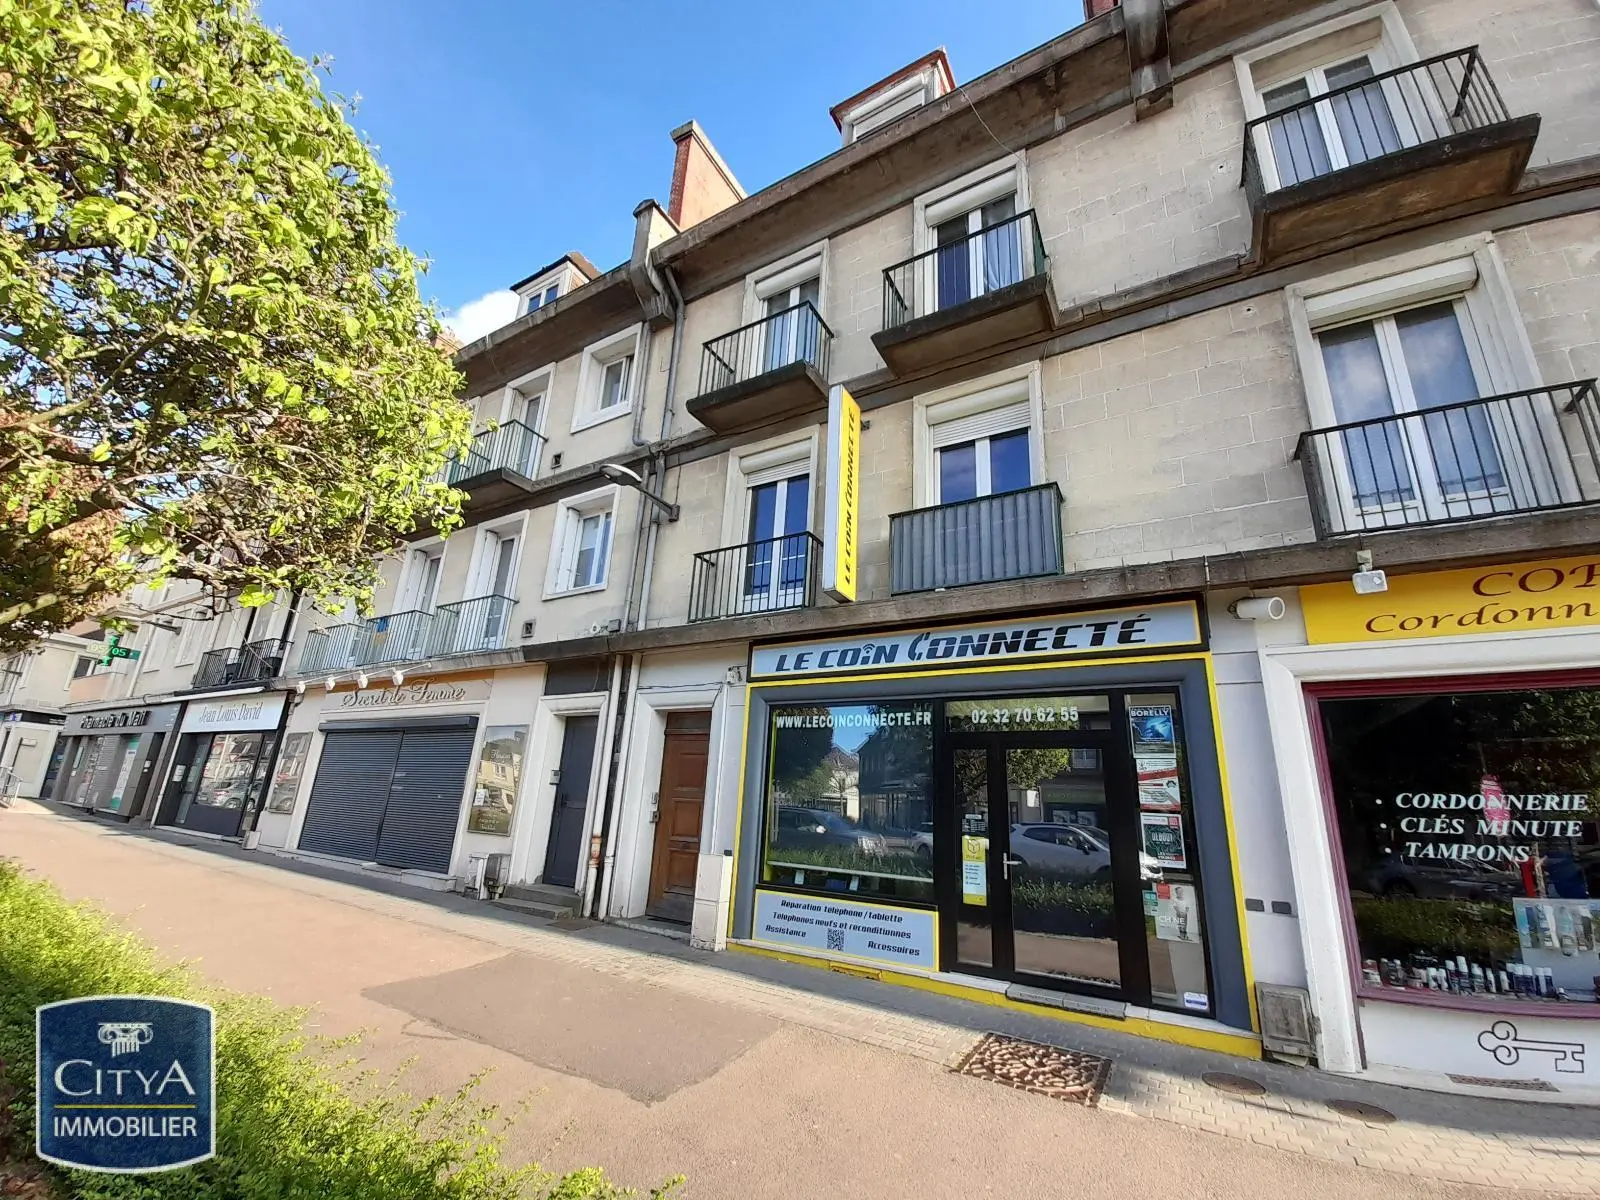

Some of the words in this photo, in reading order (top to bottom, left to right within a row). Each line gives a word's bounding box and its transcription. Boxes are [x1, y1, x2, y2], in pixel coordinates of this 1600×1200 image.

[1365, 602, 1600, 633] Cordonn
[775, 652, 814, 672] LE
[409, 677, 466, 701] Femme
[127, 710, 149, 727] Mail
[200, 706, 217, 722] Jean
[217, 704, 238, 721] Louis
[238, 701, 263, 721] David
[776, 711, 932, 729] WWW.LECOINCONNECTE.FR
[971, 709, 988, 724] 02
[993, 708, 1010, 723] 32
[1014, 707, 1032, 723] 70
[1036, 706, 1055, 722] 62
[1060, 706, 1079, 722] 55
[1131, 709, 1169, 717] BORELLY
[1395, 792, 1589, 811] CORDONNERIE
[1400, 814, 1465, 835] CLÉS
[1475, 819, 1583, 838] MINUTE
[1405, 841, 1531, 863] TAMPONS
[765, 924, 806, 938] Assistance
[815, 919, 838, 928] neufs
[839, 922, 848, 930] et
[867, 940, 920, 956] Accessoires
